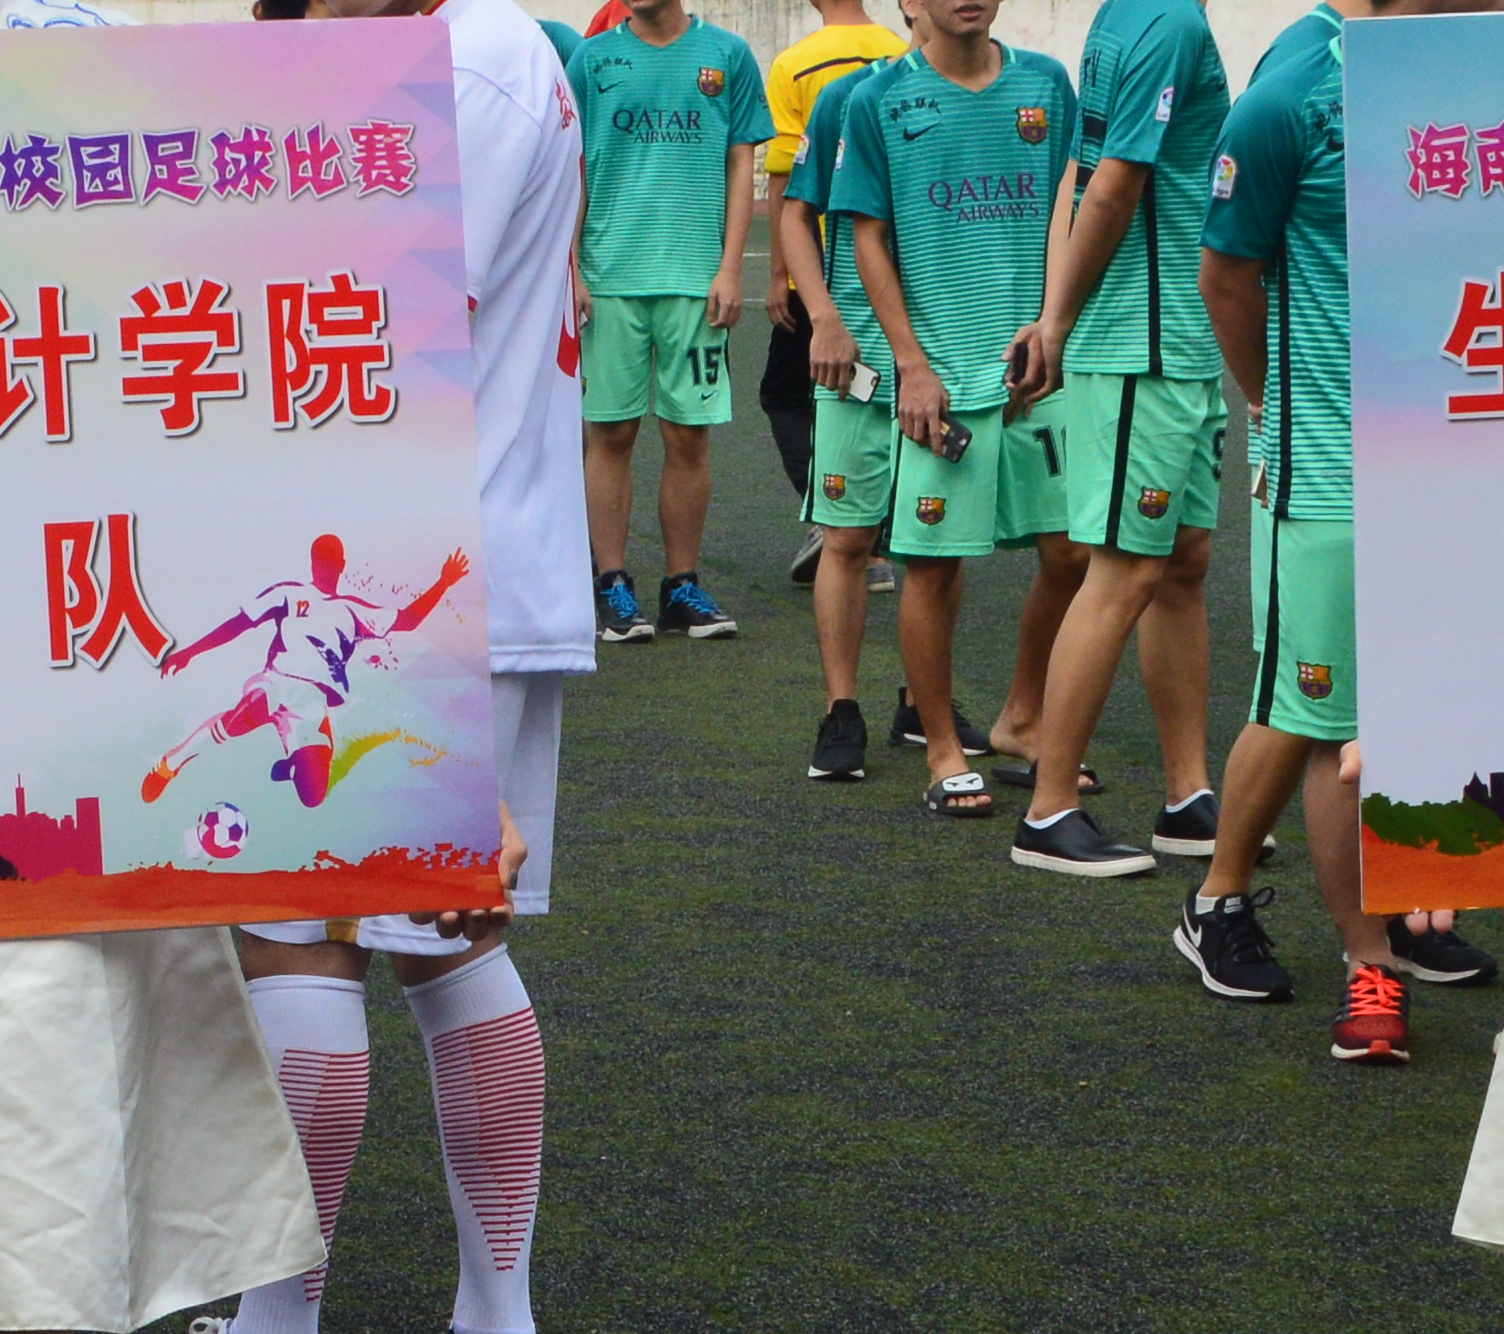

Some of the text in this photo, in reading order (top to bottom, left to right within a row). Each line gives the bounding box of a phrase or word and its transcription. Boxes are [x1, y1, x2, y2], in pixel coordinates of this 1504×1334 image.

[612, 108, 702, 133] QATAR
[633, 131, 702, 144] AIRWAYS
[927, 173, 1037, 212] QATAR
[955, 202, 1040, 224] AIRWAYS
[686, 346, 723, 386] 15
[1032, 424, 1067, 478] 1
[295, 599, 310, 618] 12
